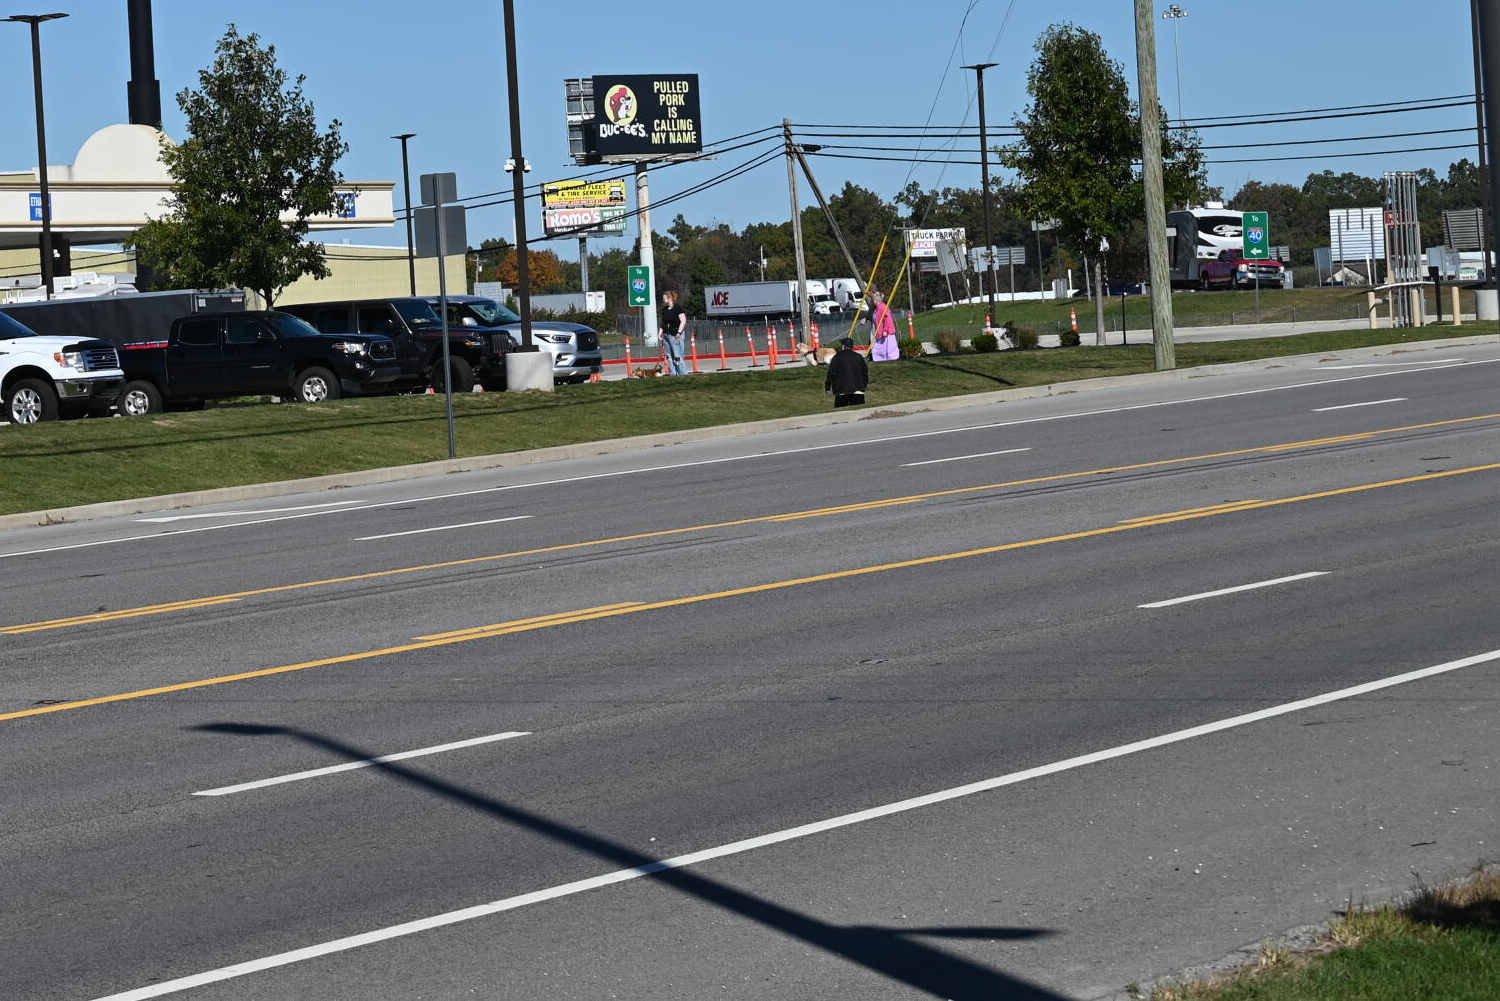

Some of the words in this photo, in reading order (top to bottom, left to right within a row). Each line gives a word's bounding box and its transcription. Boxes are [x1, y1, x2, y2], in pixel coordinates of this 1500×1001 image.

[653, 81, 689, 93] PULLED
[659, 94, 685, 106] PORK
[667, 106, 678, 118] IS
[654, 119, 693, 131] CALLING
[651, 132, 667, 144] MY
[669, 131, 697, 144] NAME
[911, 232, 934, 240] TRUCK
[1249, 231, 1262, 239] 40
[711, 290, 729, 306] ACE
